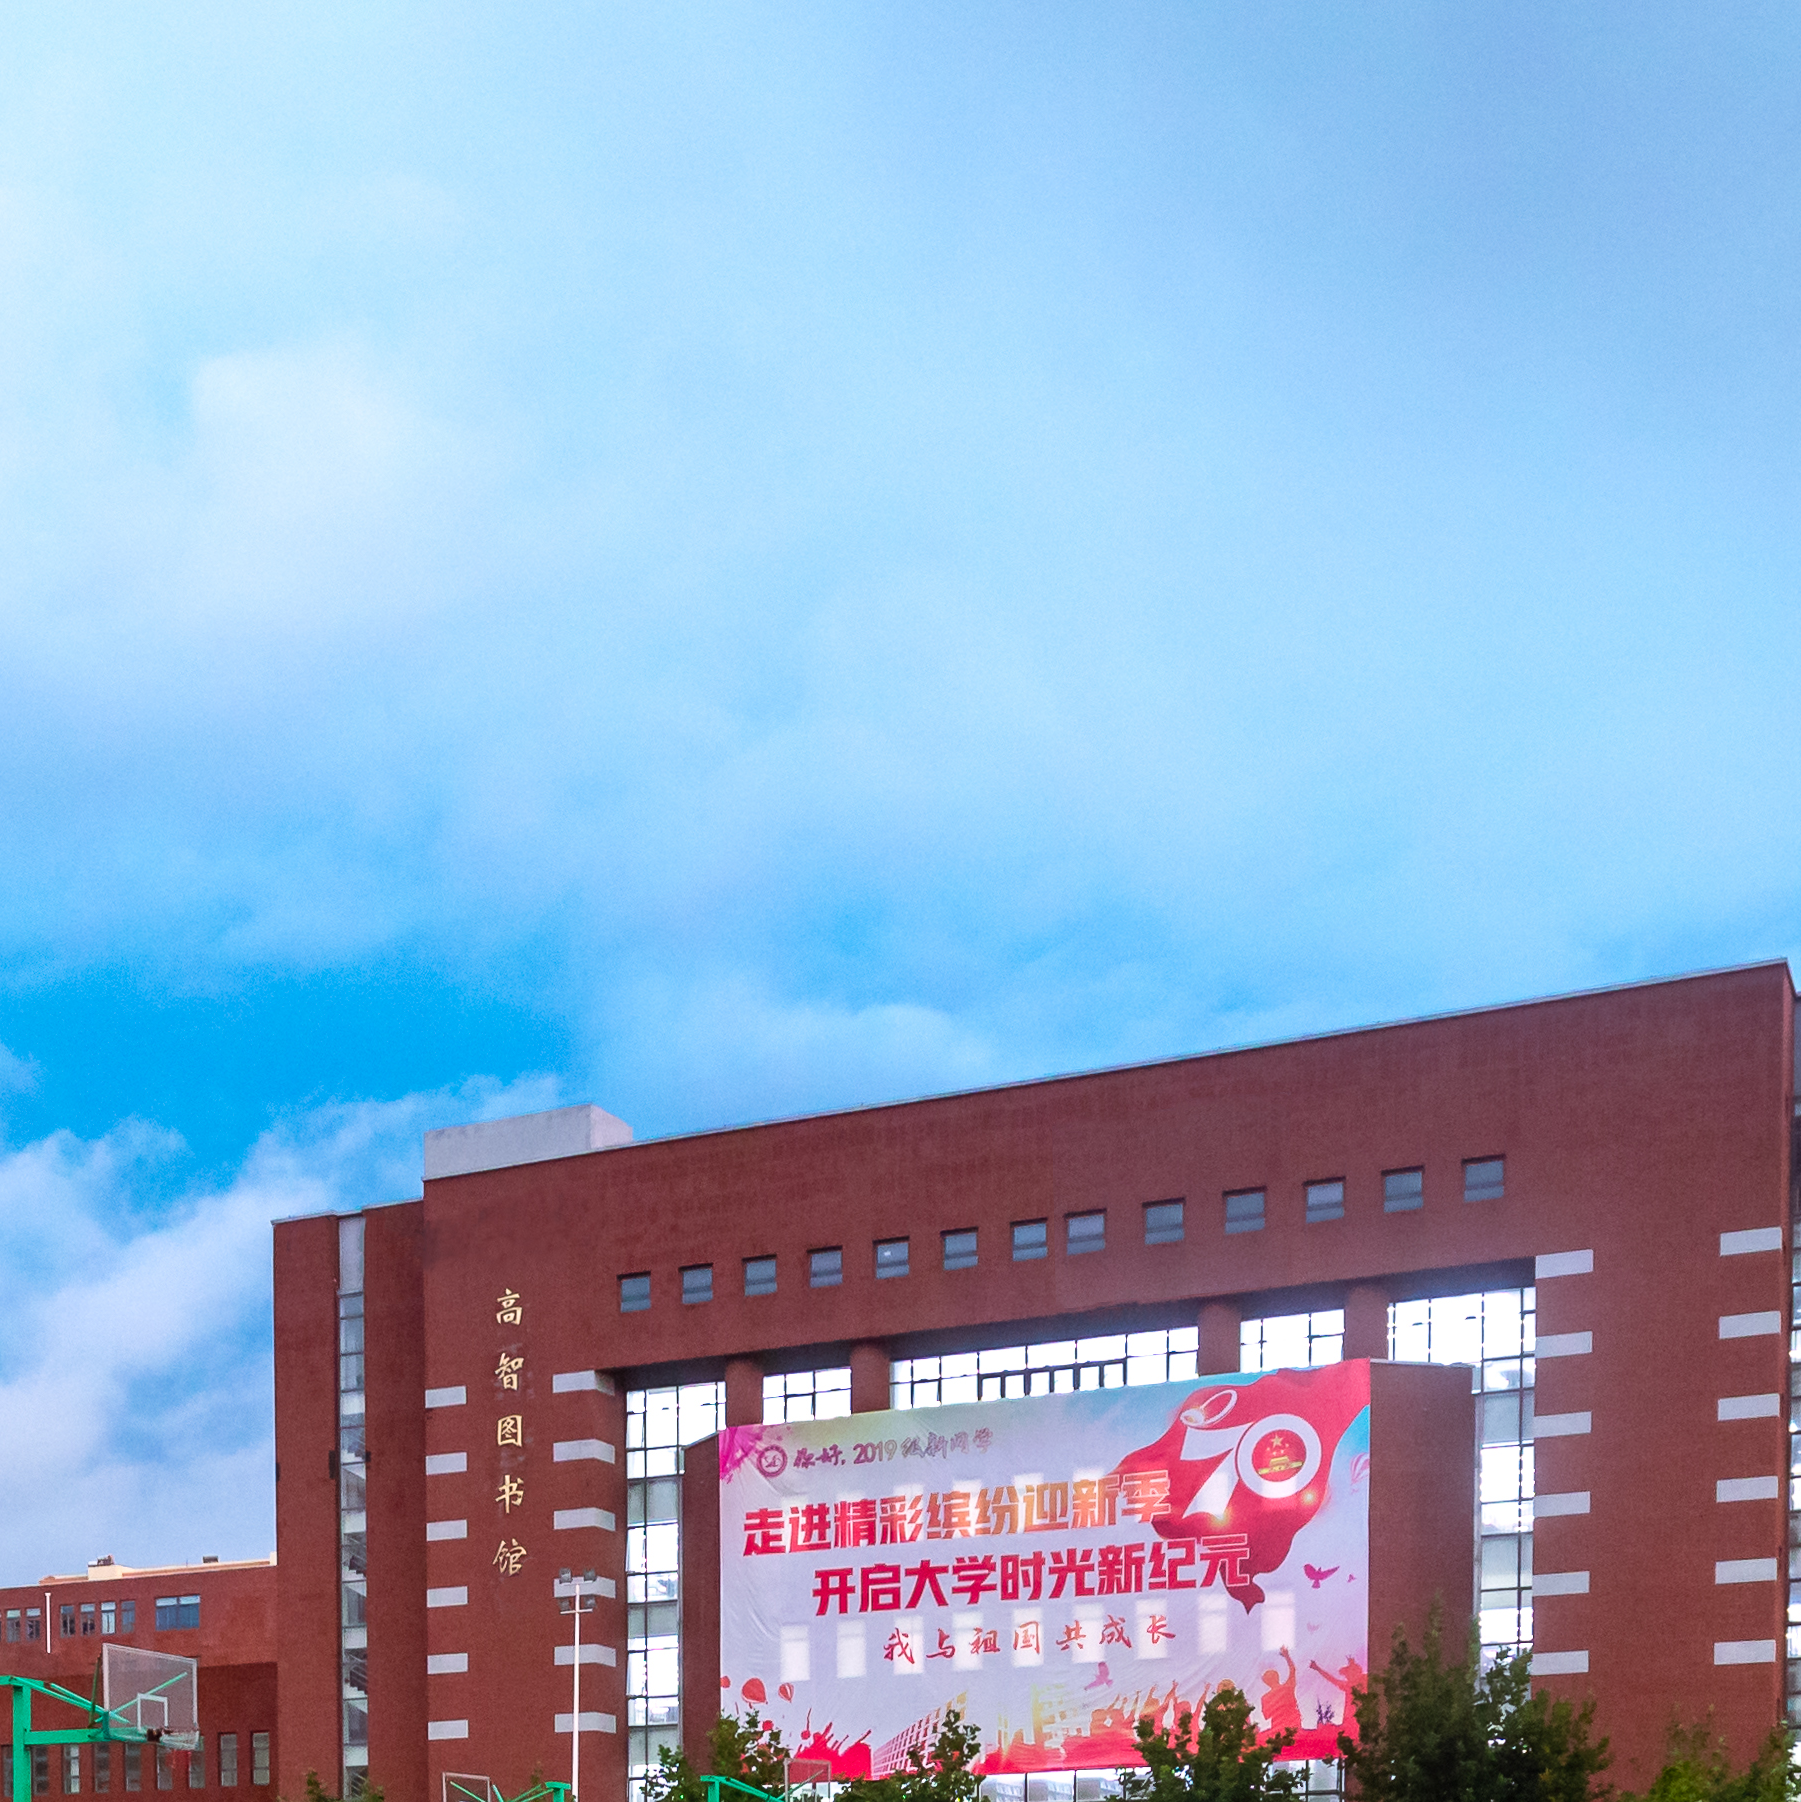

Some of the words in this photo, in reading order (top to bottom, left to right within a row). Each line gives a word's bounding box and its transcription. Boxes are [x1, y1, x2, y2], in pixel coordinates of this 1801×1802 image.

[492, 1288, 527, 1577] 高智图书馆
[1179, 1408, 1322, 1519] 70
[743, 1470, 1171, 1557] 走进精彩缤纷迎新季
[812, 1533, 1251, 1616] 开启大学时光新纪元
[883, 1614, 1176, 1664] 我与祖国共成长
